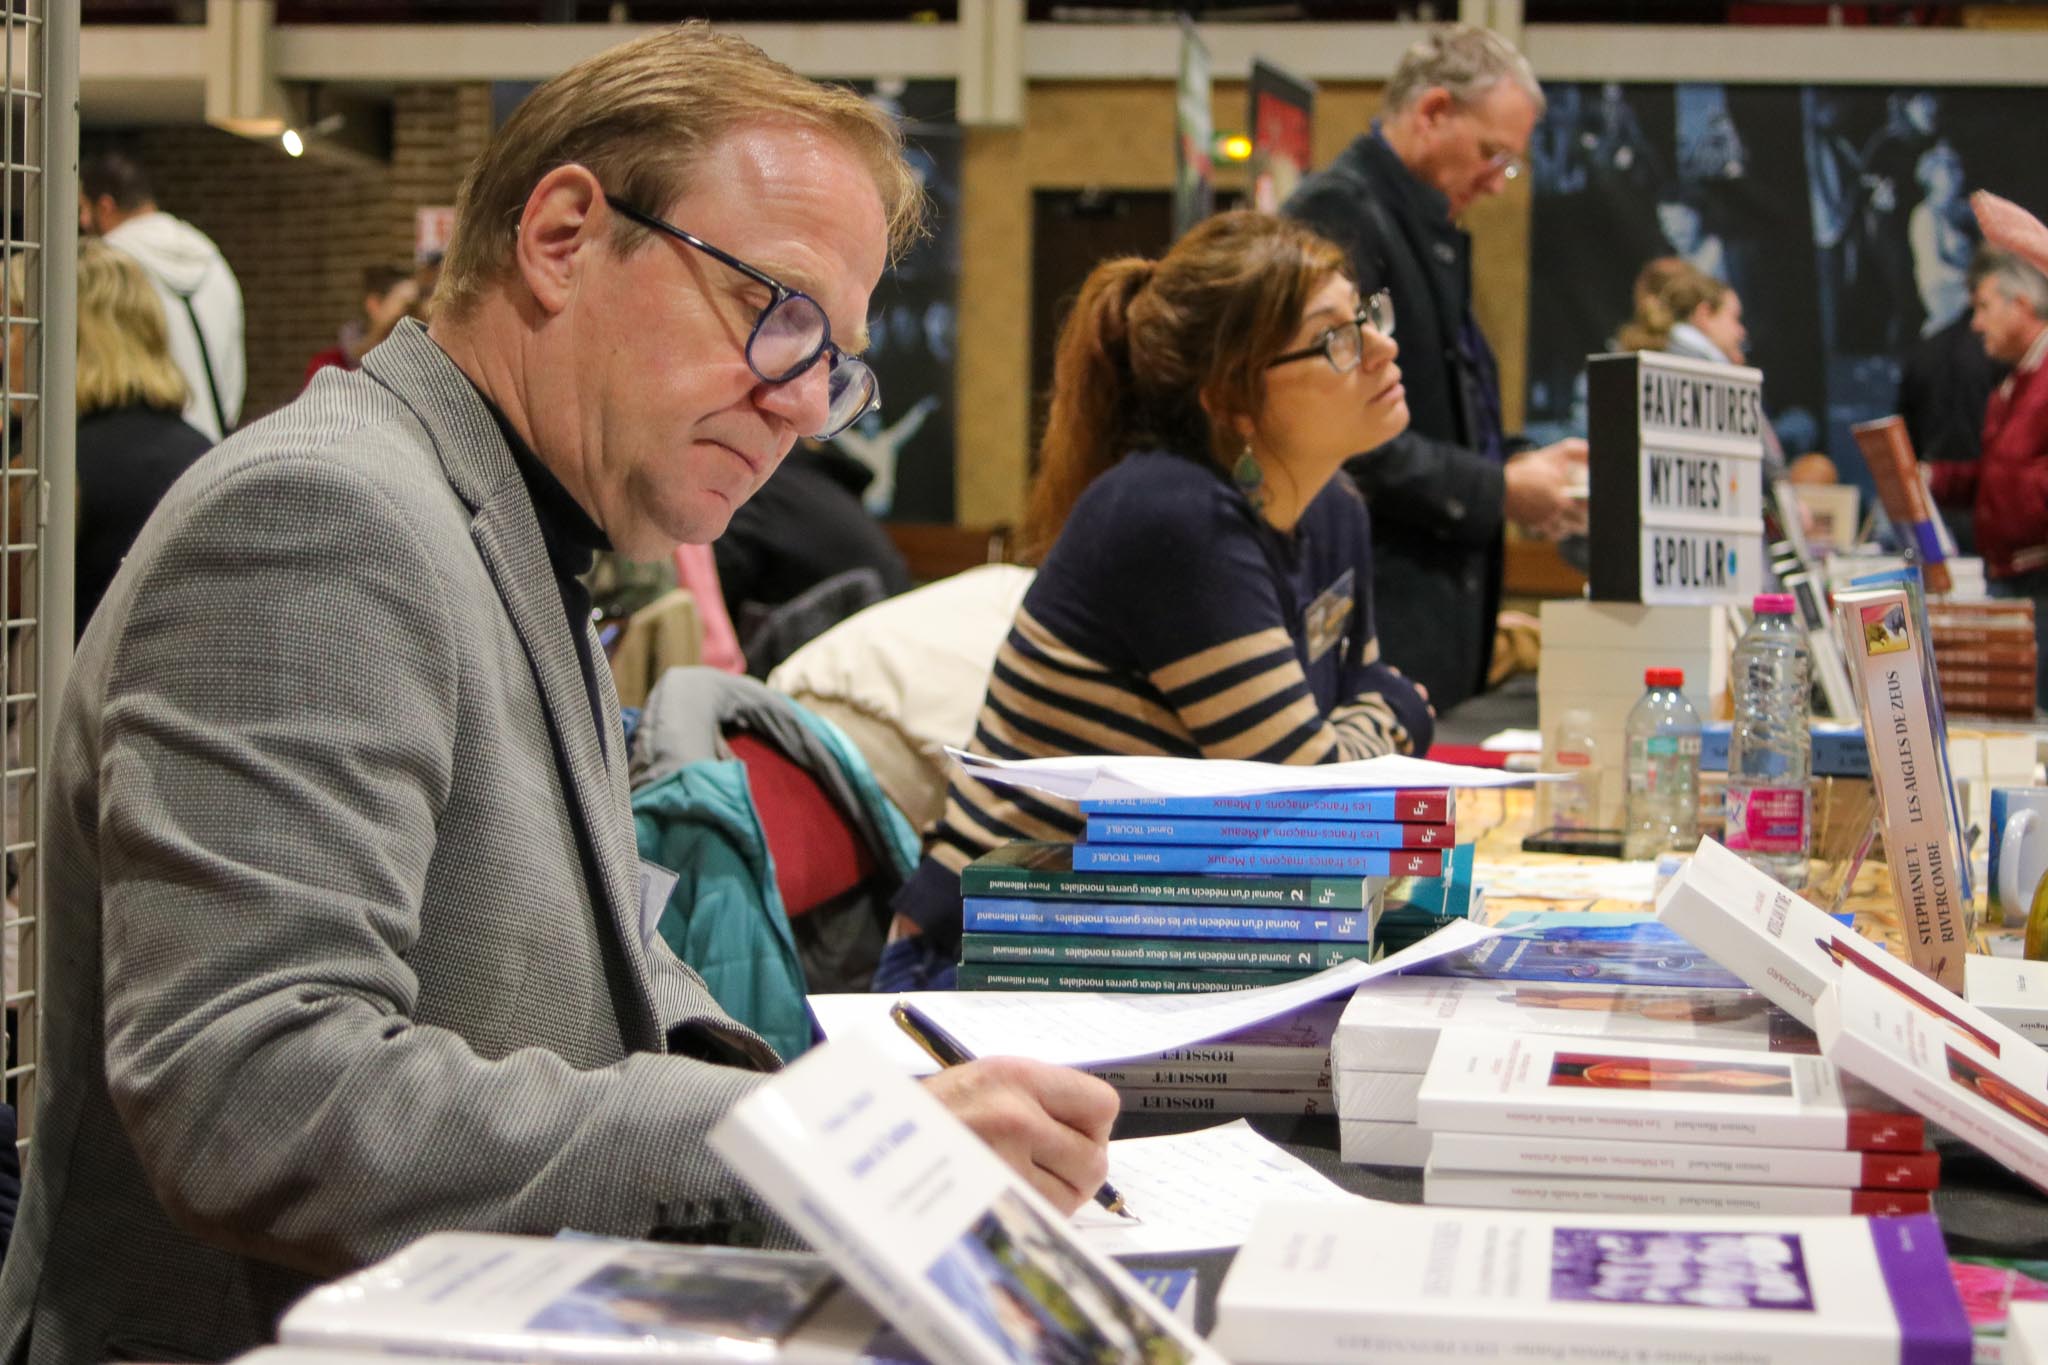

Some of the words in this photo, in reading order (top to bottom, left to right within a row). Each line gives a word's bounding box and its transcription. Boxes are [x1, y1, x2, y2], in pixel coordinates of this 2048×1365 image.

[1644, 373, 1760, 435] #AVENTURES
[1650, 456, 1721, 508] MYTHES
[1654, 535, 1726, 587] &POLAR
[1886, 670, 1904, 710] ZEUS
[1894, 712, 1909, 738] DE
[1899, 737, 1917, 793] AIGLES
[1214, 800, 1250, 811] Meaux
[1352, 802, 1372, 814] Les
[1909, 794, 1923, 823] LES
[1148, 825, 1174, 835] Daniel
[1220, 827, 1258, 838] Meaux
[1361, 830, 1380, 841] Les
[1133, 853, 1160, 863] Daniel
[1208, 855, 1246, 866] Meaux
[1347, 857, 1367, 868] Les
[990, 880, 1027, 890] Hillemand
[1028, 881, 1050, 890] Pierre
[1060, 883, 1105, 893] mondiales
[1106, 884, 1138, 893] guerres
[1139, 885, 1162, 895] deux
[1163, 887, 1175, 896] les
[1176, 887, 1190, 895] sur
[1192, 888, 1229, 897] médecin
[1252, 890, 1284, 900] Journal
[1291, 889, 1304, 901] 2
[1926, 841, 1954, 943] RIVERCOMBE
[1906, 858, 1933, 945] STEPHANIE
[977, 912, 1018, 921] Hillemand
[1020, 912, 1044, 922] Pierre
[1055, 914, 1103, 924] mondiales
[1106, 914, 1140, 925] guerres
[1142, 916, 1166, 926] deux
[1168, 917, 1180, 926] les
[1183, 918, 1197, 926] sur
[1199, 918, 1240, 927] médecin
[1266, 920, 1301, 930] Journal
[1315, 920, 1328, 930] 1
[993, 946, 1031, 956] Hillemand
[1032, 947, 1055, 956] Pierre
[1065, 948, 1110, 959] mondiales
[1112, 948, 1144, 959] guerres
[1146, 950, 1168, 960] deux
[1169, 950, 1181, 960] les
[1183, 951, 1196, 959] sur
[1198, 951, 1236, 961] médecin
[1259, 954, 1291, 964] Journal
[1299, 952, 1311, 964] 2
[988, 975, 1026, 985] Hillemand
[1027, 976, 1049, 985] Pierre
[1060, 977, 1105, 988] mondiales
[1106, 978, 1138, 988] guerres
[1140, 980, 1162, 990] deux
[1177, 981, 1190, 989] sur
[1163, 980, 1175, 991] les
[1159, 1050, 1234, 1062] BOSSUET
[1152, 1072, 1227, 1084] BOSSUET
[1142, 1096, 1215, 1109] BOSSUET
